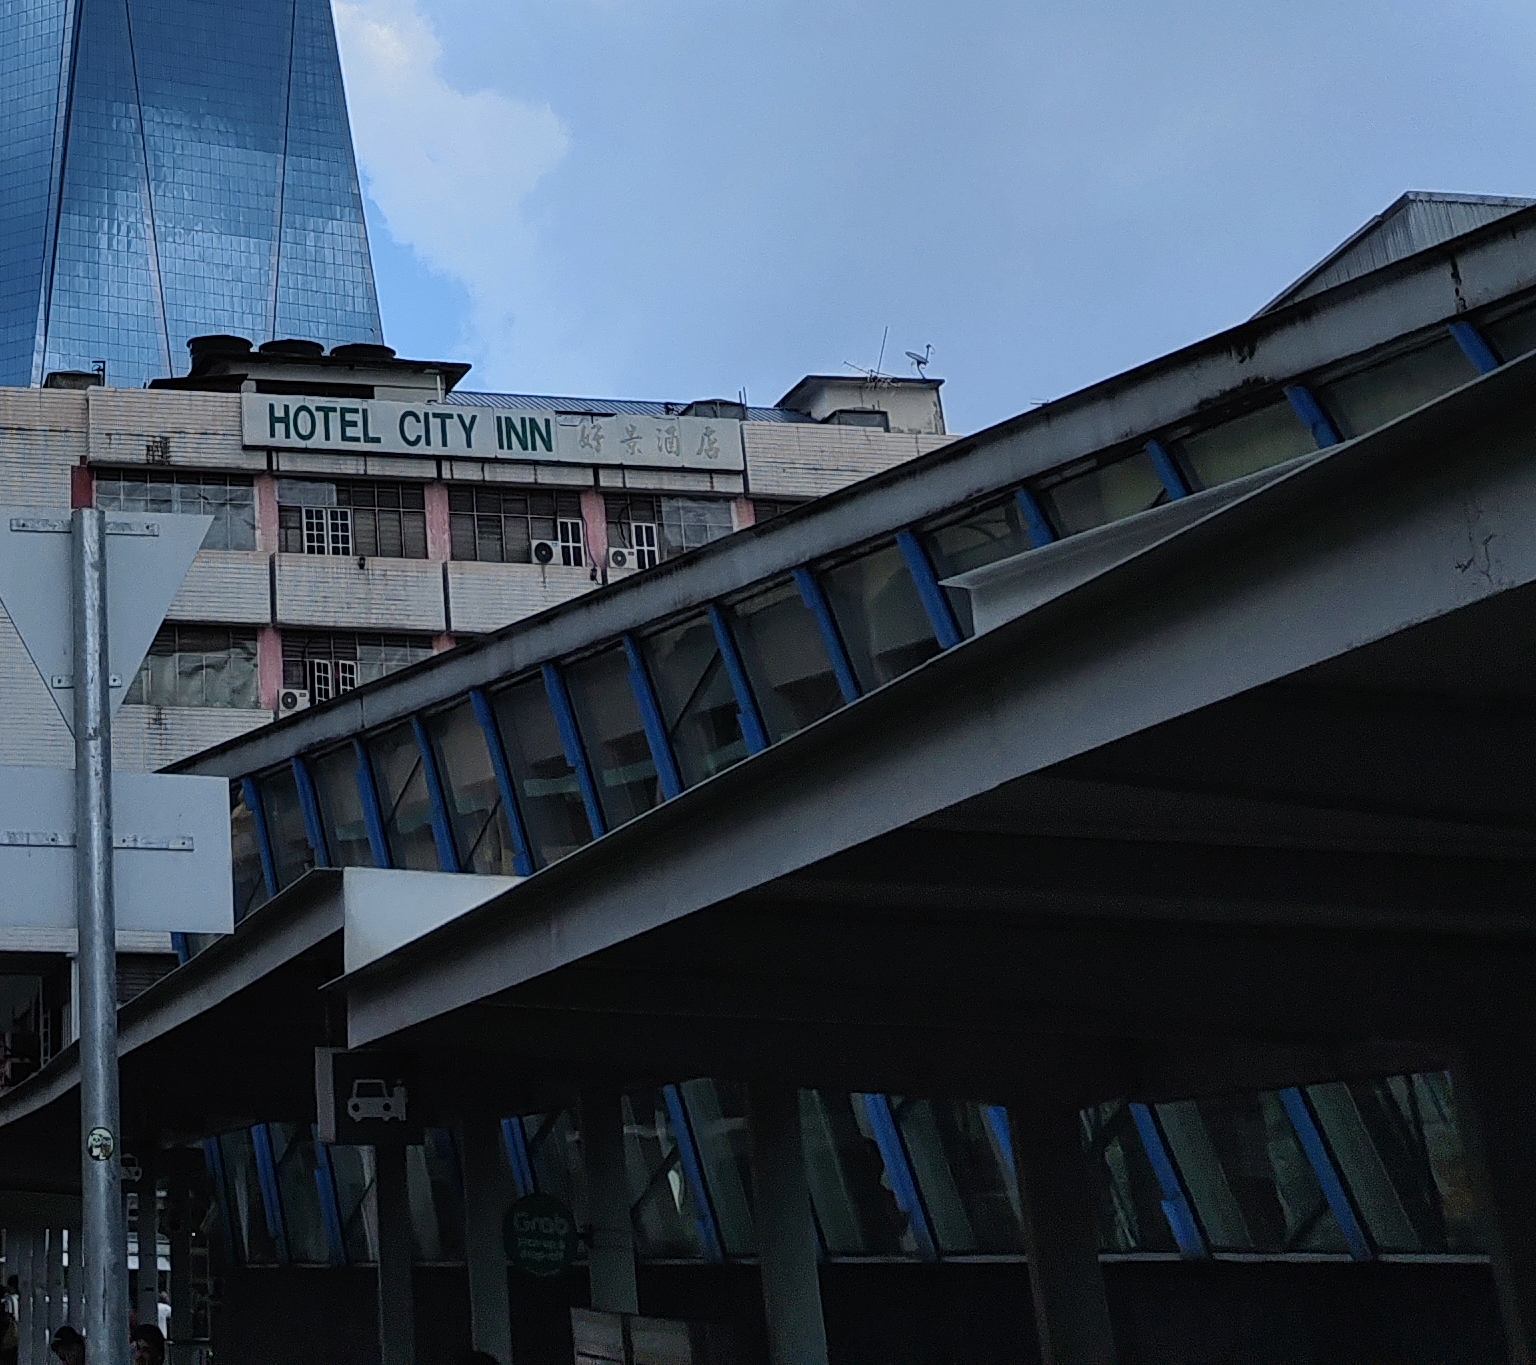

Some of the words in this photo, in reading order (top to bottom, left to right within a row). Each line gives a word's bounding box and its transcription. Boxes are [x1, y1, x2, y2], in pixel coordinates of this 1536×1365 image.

[268, 401, 381, 445] HOTEL
[399, 410, 478, 449] CITY
[496, 415, 553, 454] INN
